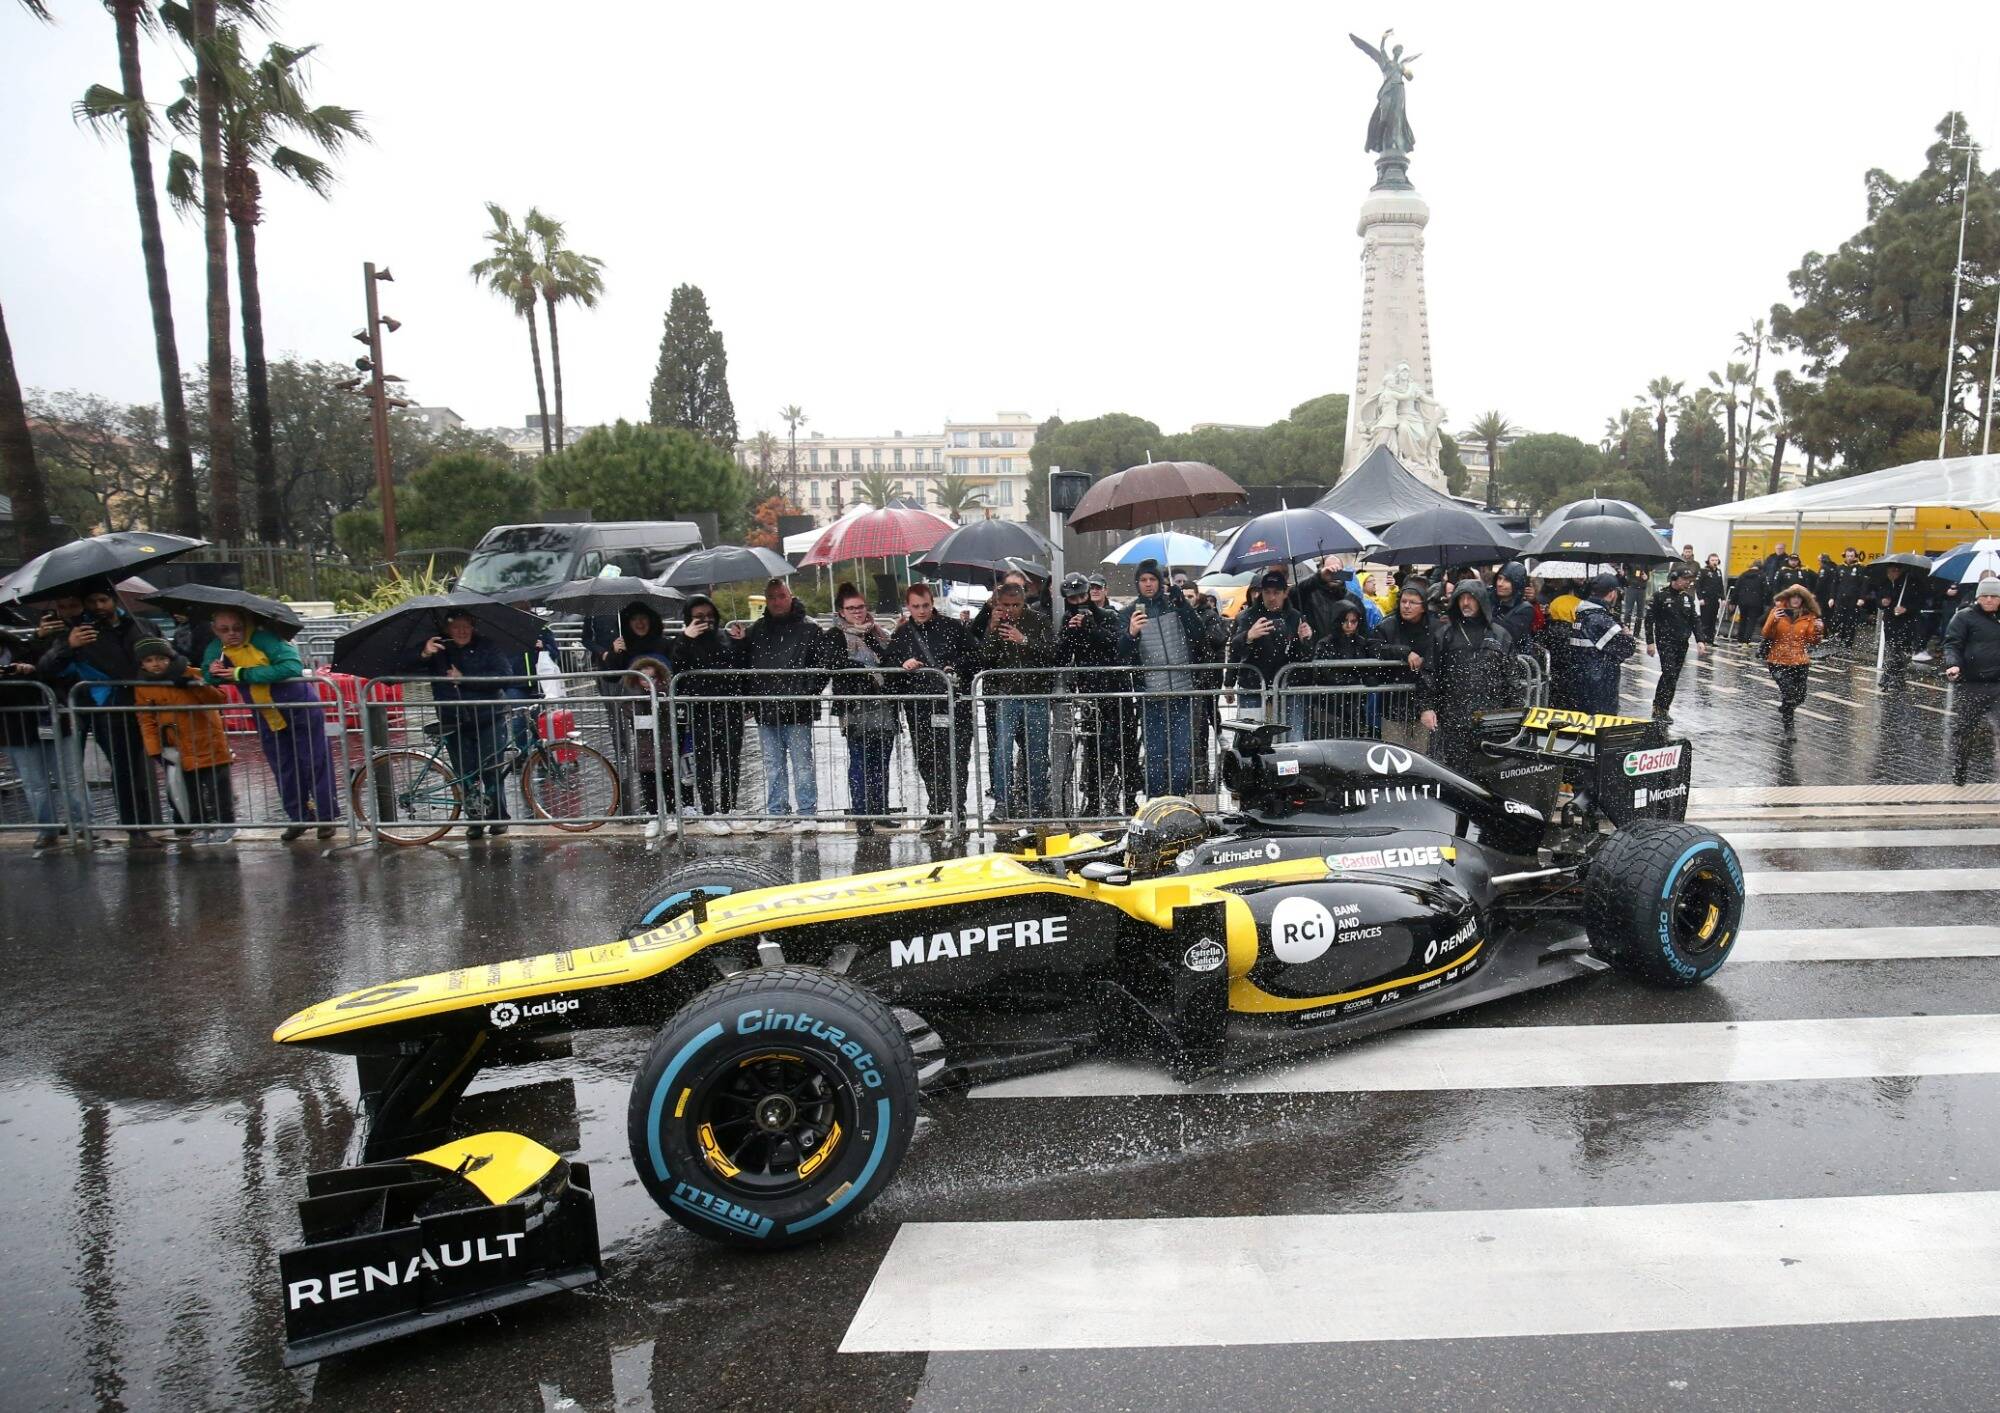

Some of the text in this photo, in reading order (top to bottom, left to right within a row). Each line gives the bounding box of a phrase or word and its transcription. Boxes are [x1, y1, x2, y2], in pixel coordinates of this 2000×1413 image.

[1638, 749, 1677, 772] Castrol
[1344, 783, 1441, 807] INFINITI
[1649, 783, 1687, 802] Microsoft
[1212, 848, 1262, 865] ultimate
[1341, 846, 1442, 868] Castrol EDGE
[1332, 903, 1361, 917] BANK
[1283, 913, 1324, 944] RCi
[1338, 917, 1360, 930] AND
[890, 915, 1068, 968] MAPFRE
[1338, 926, 1382, 944] SERVICES
[1440, 916, 1477, 955] RENAULT
[523, 999, 579, 1017] LaLiga
[1301, 1009, 1336, 1020] HECHTER
[669, 1181, 775, 1239] PIRELLI
[288, 1232, 526, 1310] RENAULT
